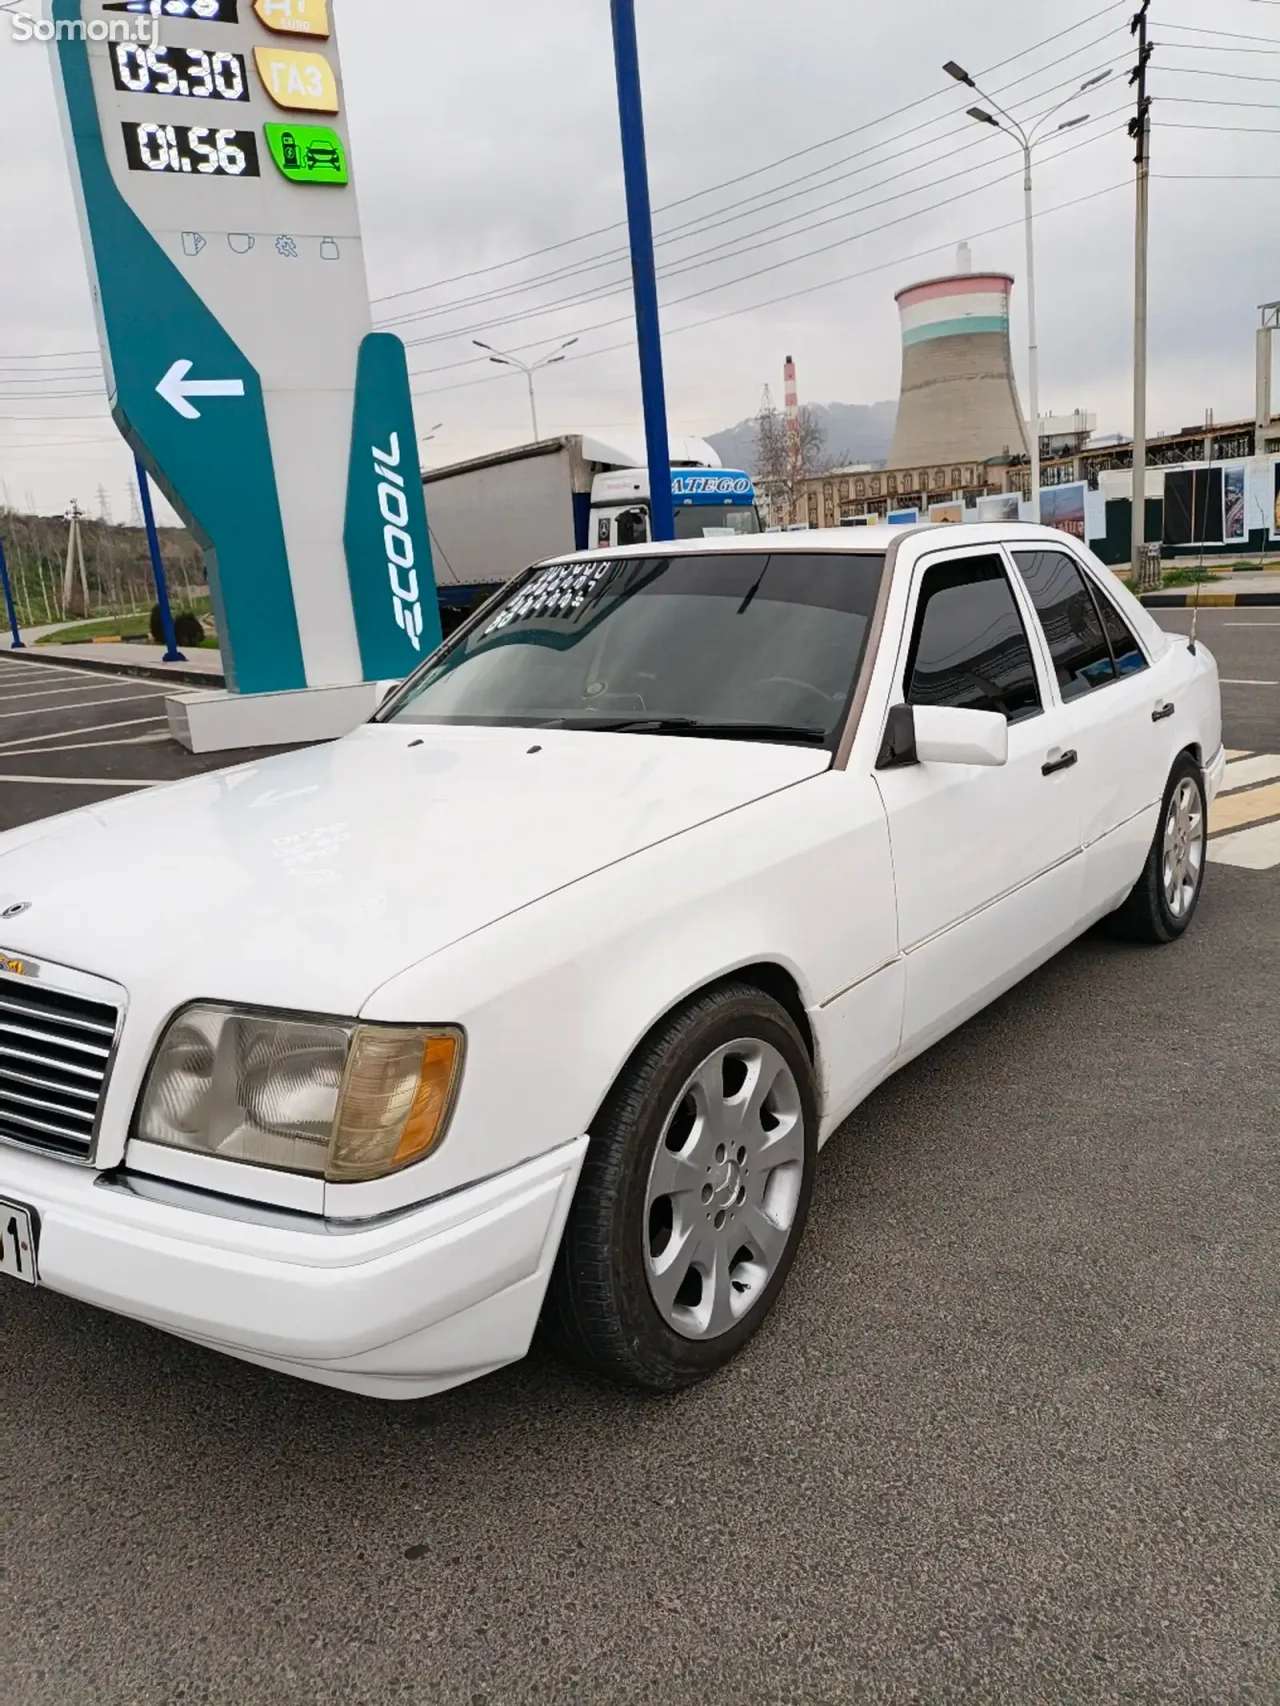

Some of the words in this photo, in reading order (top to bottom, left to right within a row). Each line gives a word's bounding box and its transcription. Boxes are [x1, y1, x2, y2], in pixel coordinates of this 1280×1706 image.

[115, 42, 244, 100] 05.30
[269, 61, 323, 98] ГАЗ
[137, 122, 246, 175] 01.56
[671, 476, 751, 495] ATEGO
[371, 431, 424, 652] ECOOIL
[0, 1215, 23, 1273] 1
